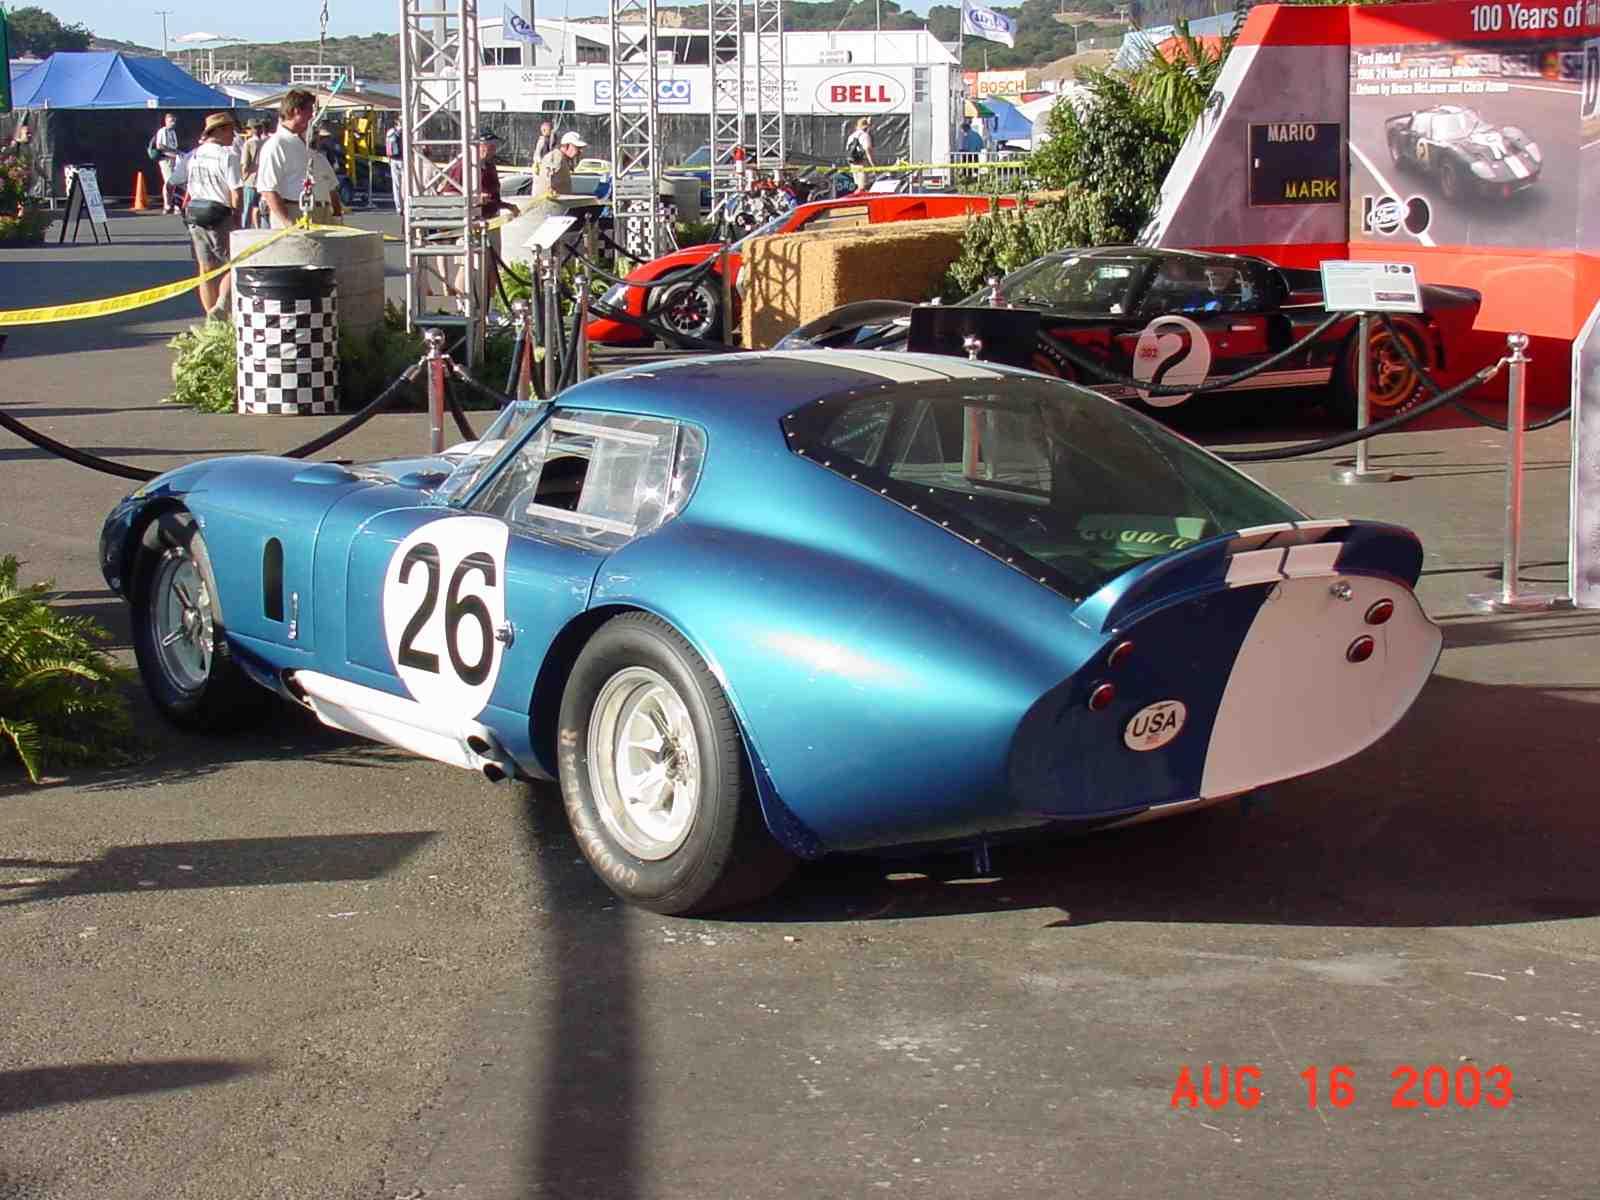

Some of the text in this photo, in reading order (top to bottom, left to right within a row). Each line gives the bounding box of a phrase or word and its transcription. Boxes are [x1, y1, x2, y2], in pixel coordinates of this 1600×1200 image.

[1470, 4, 1503, 32] 100
[1507, 3, 1558, 30] Years
[1564, 1, 1583, 28] of
[831, 85, 892, 103] BELL
[979, 80, 1025, 94] BOSCH
[1267, 123, 1316, 143] MARIO
[1284, 180, 1337, 199] MARK
[398, 541, 496, 687] 26
[1132, 709, 1177, 738] USA
